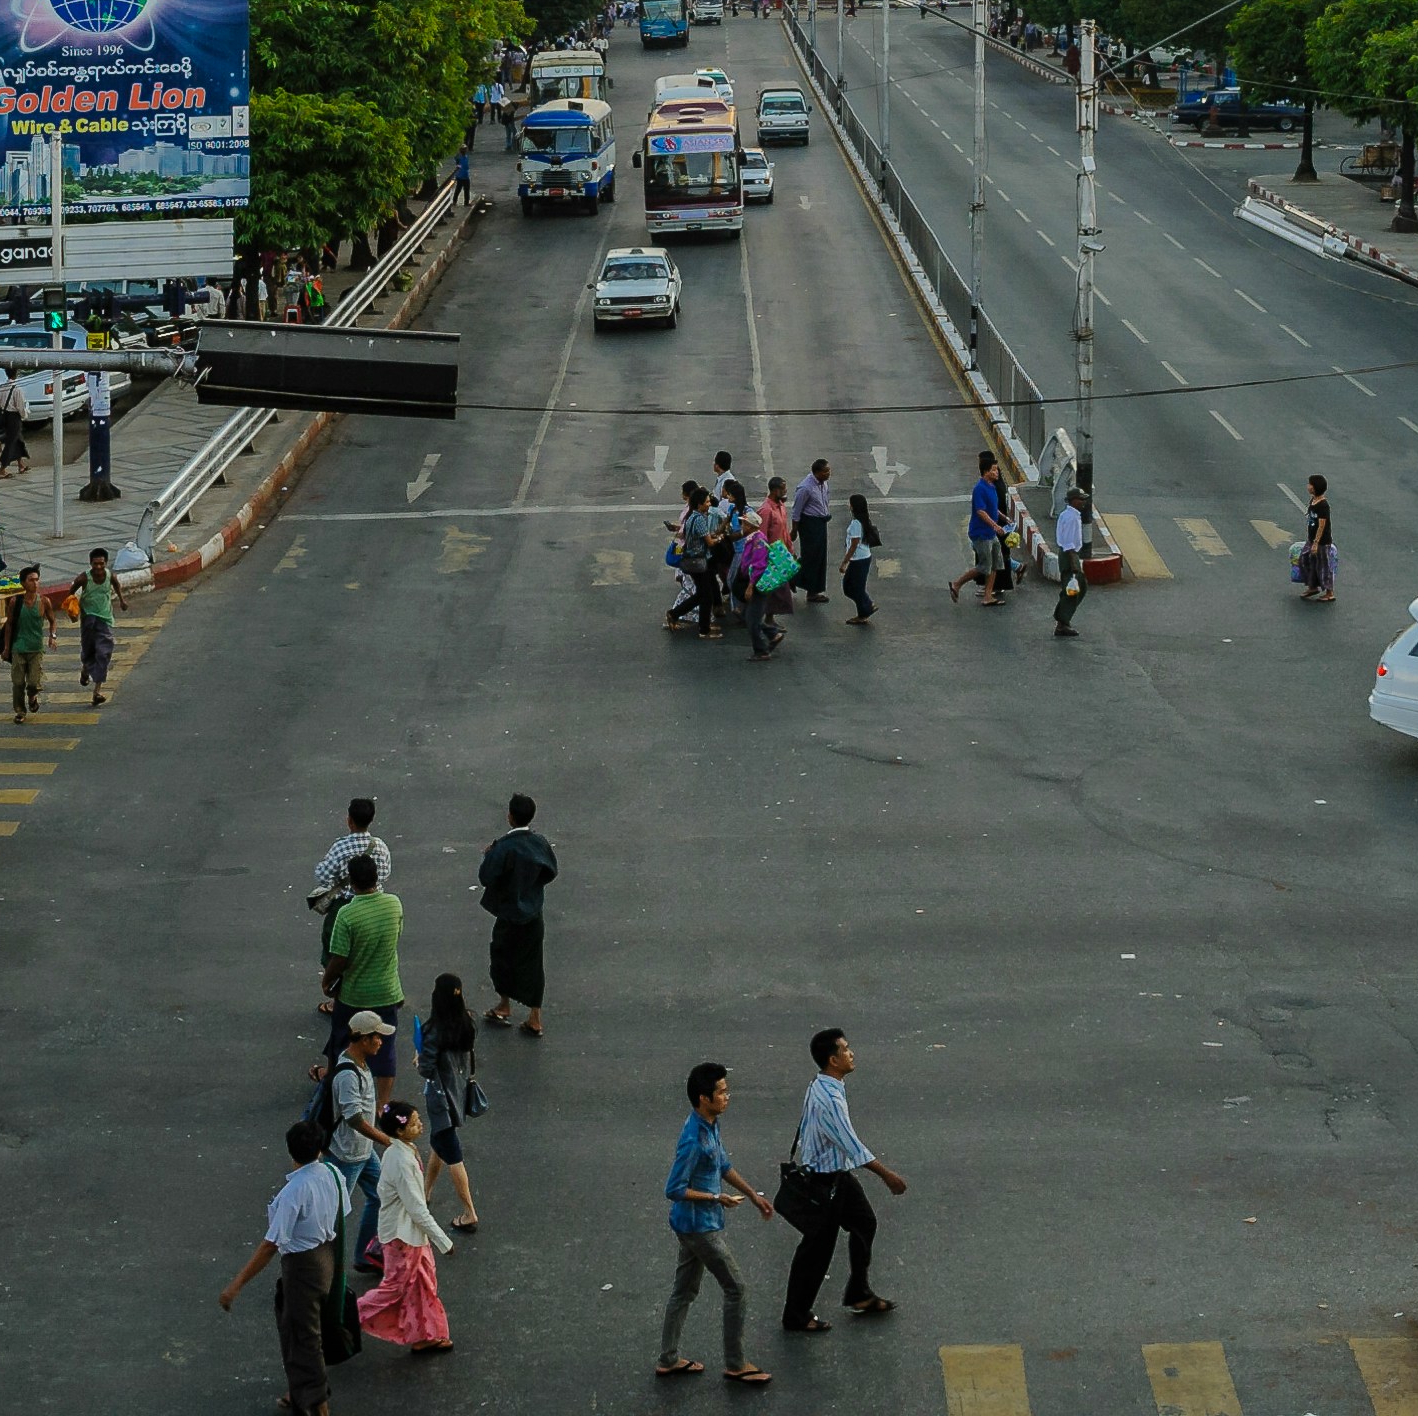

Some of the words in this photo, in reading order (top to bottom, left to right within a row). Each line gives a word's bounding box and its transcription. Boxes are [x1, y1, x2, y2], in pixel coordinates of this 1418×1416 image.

[61, 45, 93, 57] Since
[96, 44, 124, 56] 1996
[128, 82, 207, 111] Lion
[11, 119, 56, 136] Wire
[58, 118, 73, 134] &
[75, 117, 130, 133] Cable
[187, 141, 203, 151] ISO
